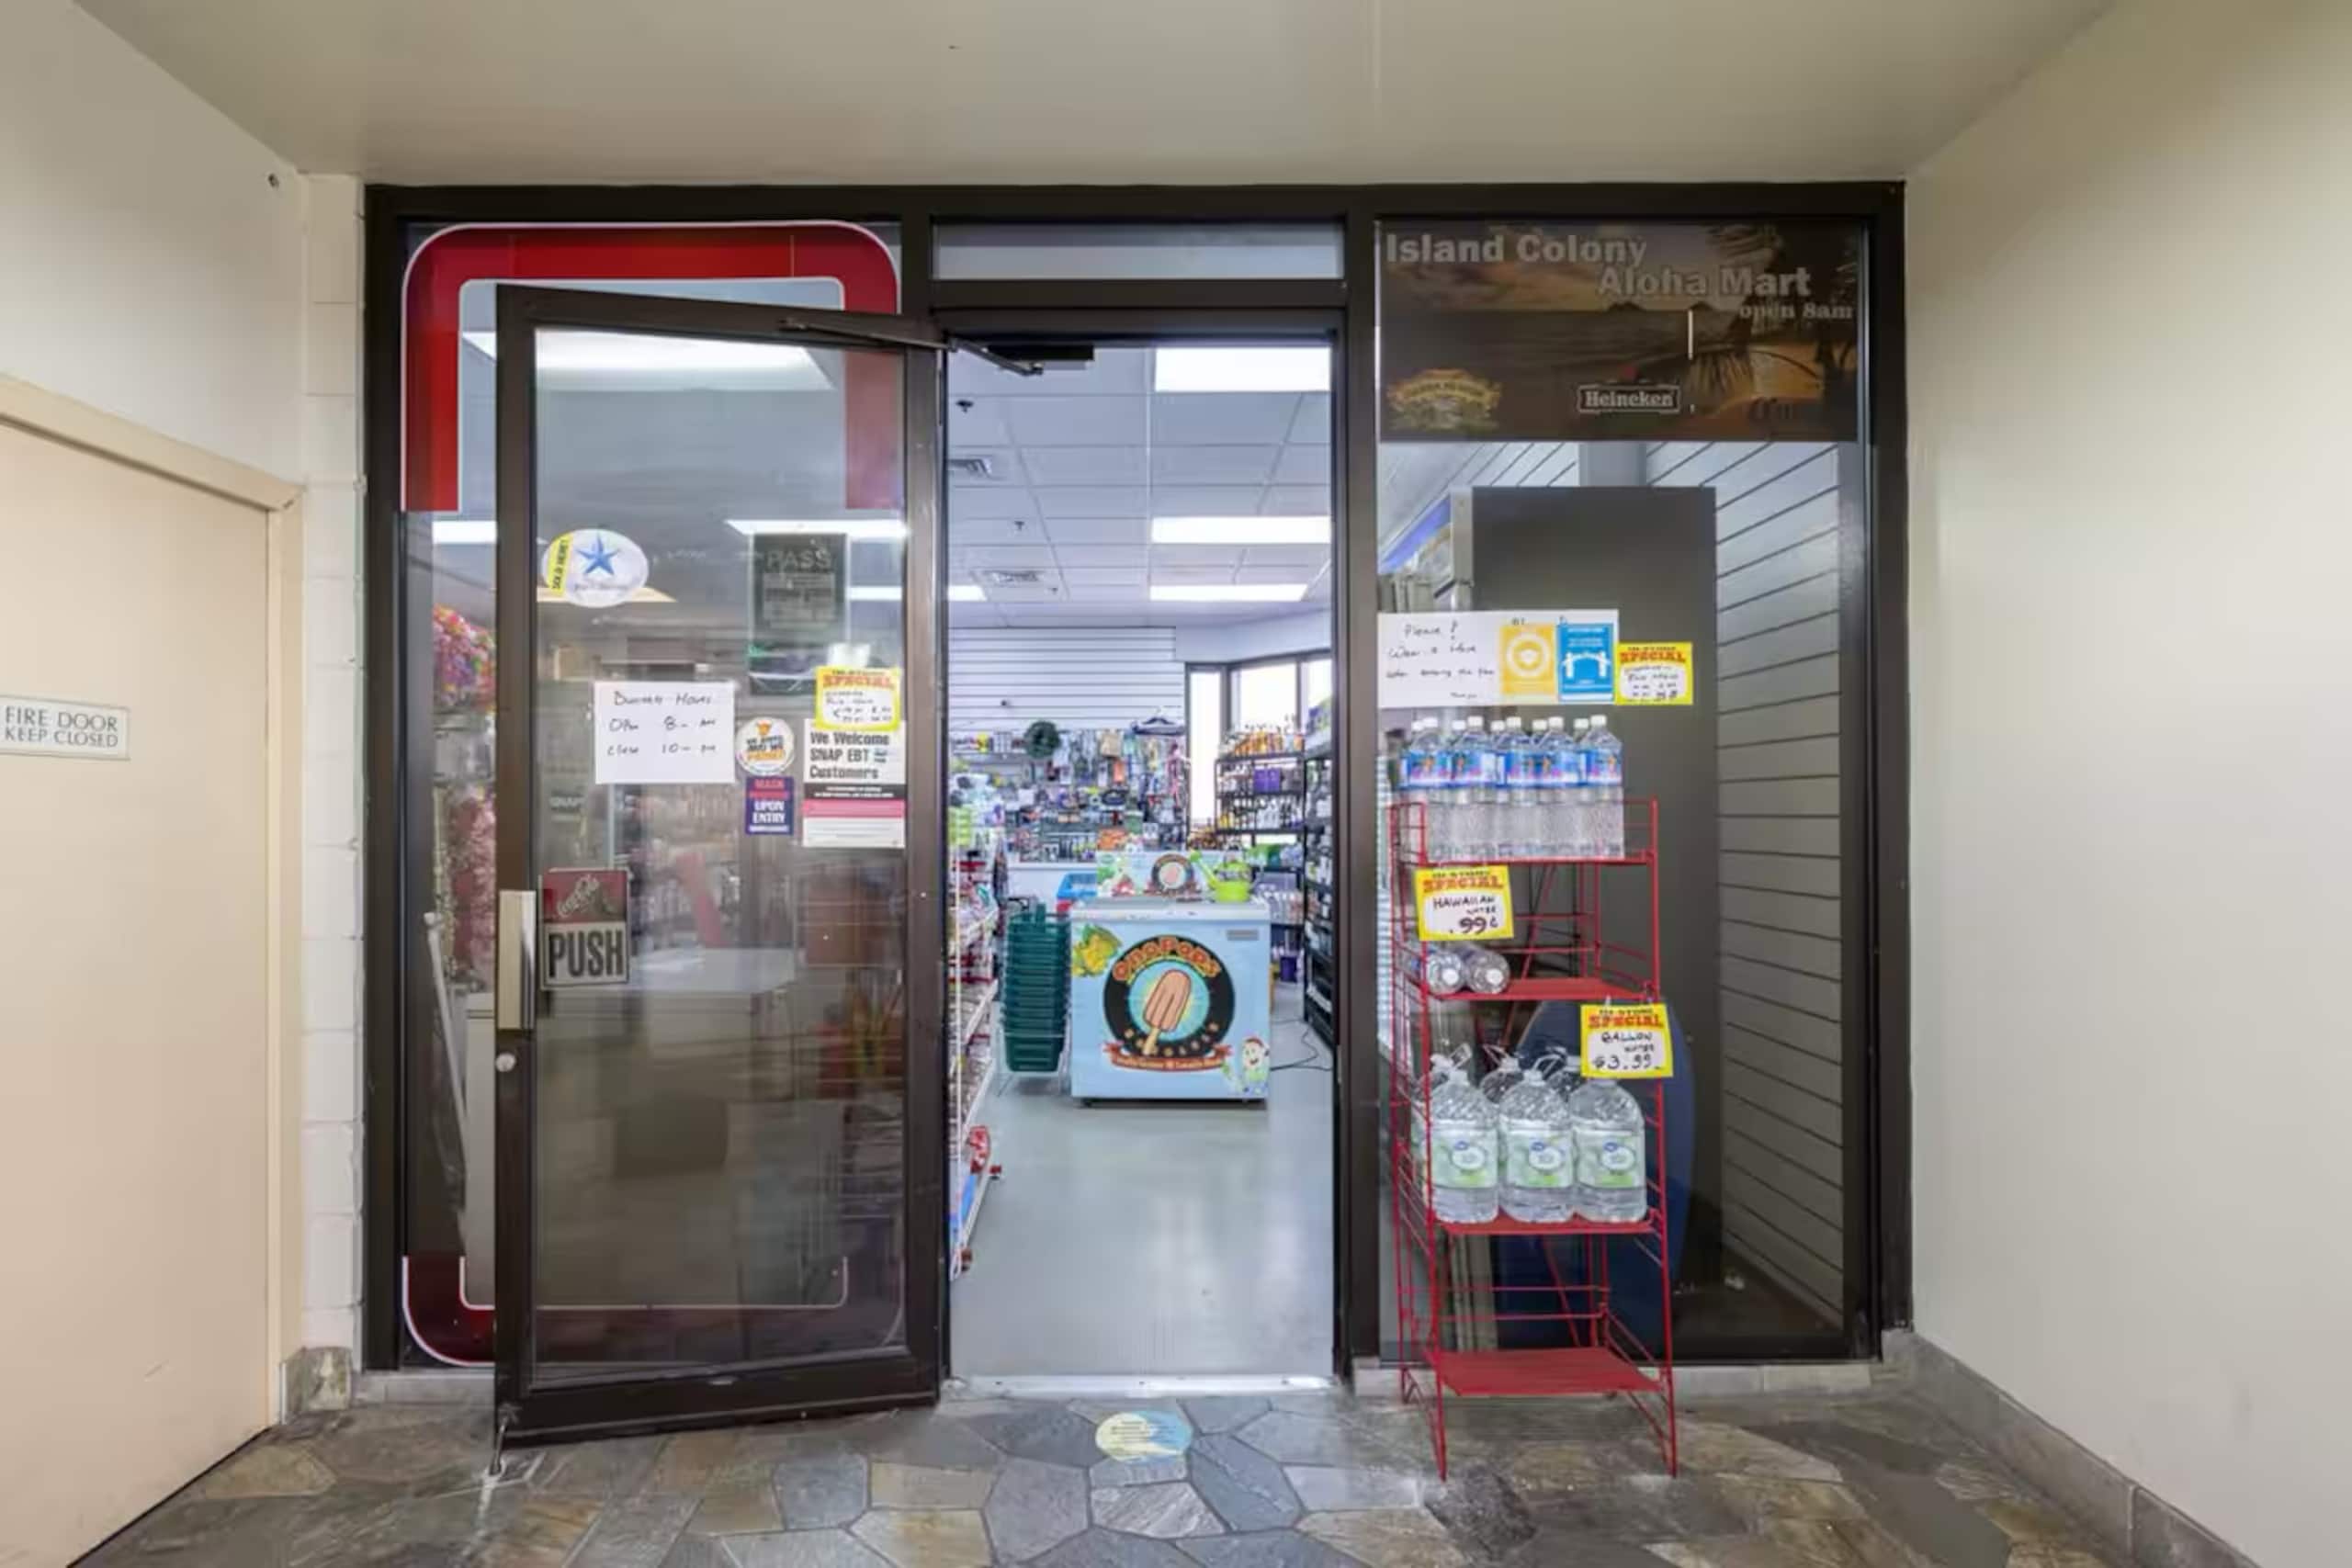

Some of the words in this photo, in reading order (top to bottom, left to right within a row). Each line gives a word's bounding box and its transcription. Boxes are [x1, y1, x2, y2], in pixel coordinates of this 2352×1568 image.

[1385, 234, 1504, 263] Island
[1517, 233, 1646, 267] Colony
[1599, 265, 1706, 295] Aloha
[1720, 266, 1812, 296] Mart
[1802, 301, 1853, 320] 8am
[1585, 390, 1673, 408] Heineken
[1620, 650, 1687, 663] SPECIAL
[5, 705, 49, 727] FIRE
[57, 711, 119, 732] DOOR
[5, 727, 48, 742] KEEP
[53, 730, 119, 748] CLOSED
[810, 732, 830, 745] We
[833, 732, 889, 746] Welcome
[809, 748, 843, 761] SNAP
[847, 749, 869, 762] EBT
[809, 765, 879, 779] Customers
[754, 800, 786, 811] UPON
[752, 811, 786, 824] ENTRY
[1423, 875, 1505, 893] SPECIAL
[548, 930, 624, 978] PUSH
[1588, 1013, 1664, 1031] SPECIAL
